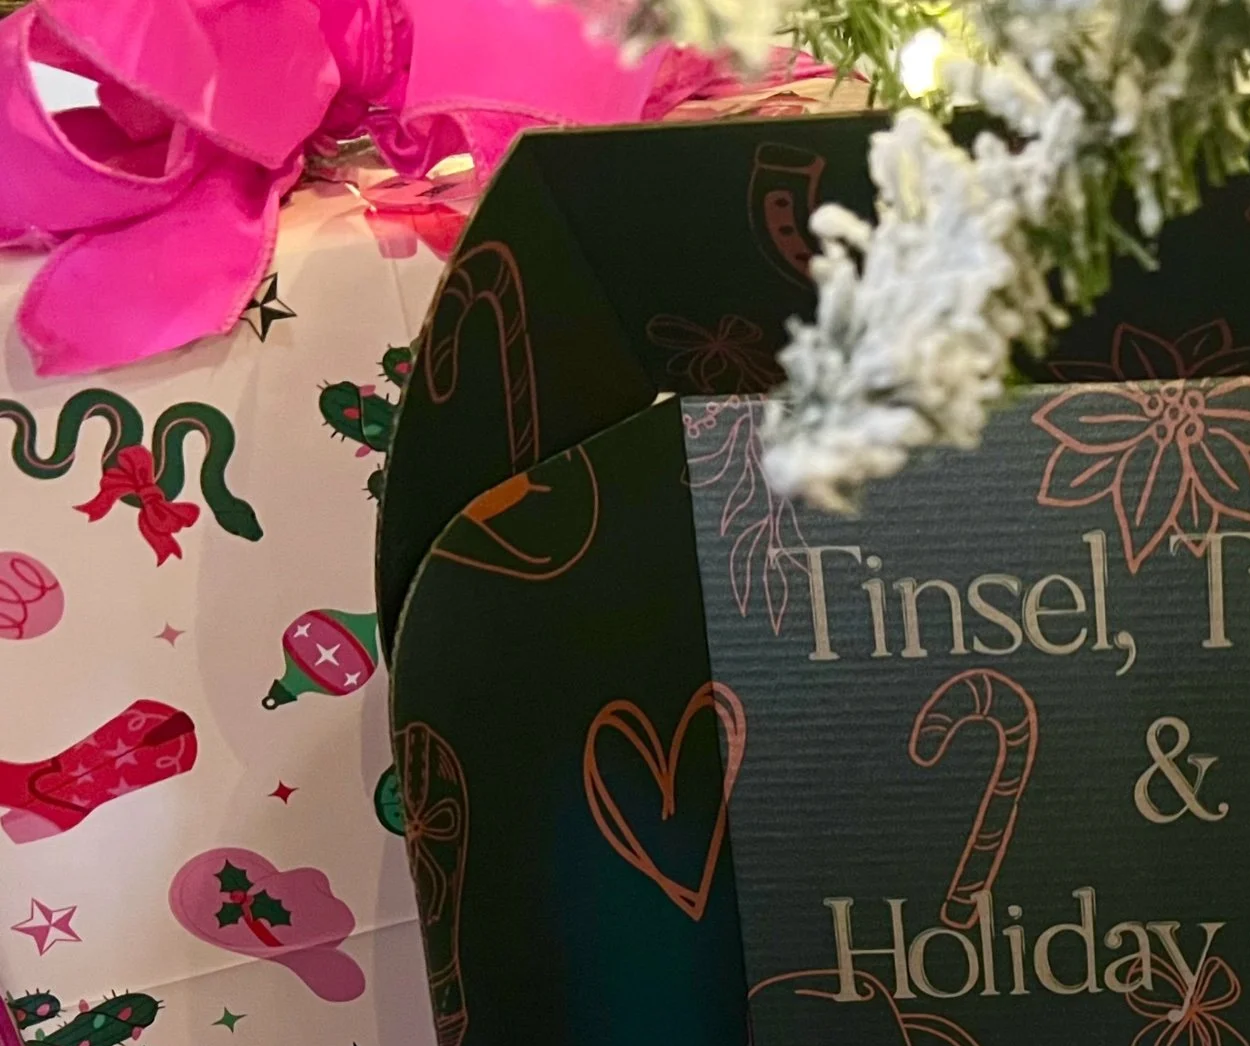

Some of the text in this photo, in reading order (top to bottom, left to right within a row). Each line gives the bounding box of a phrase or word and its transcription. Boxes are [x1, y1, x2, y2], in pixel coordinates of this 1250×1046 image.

[771, 531, 1137, 675] Tinsel,
[1134, 716, 1229, 821] &
[823, 887, 1224, 1023] Holiday
